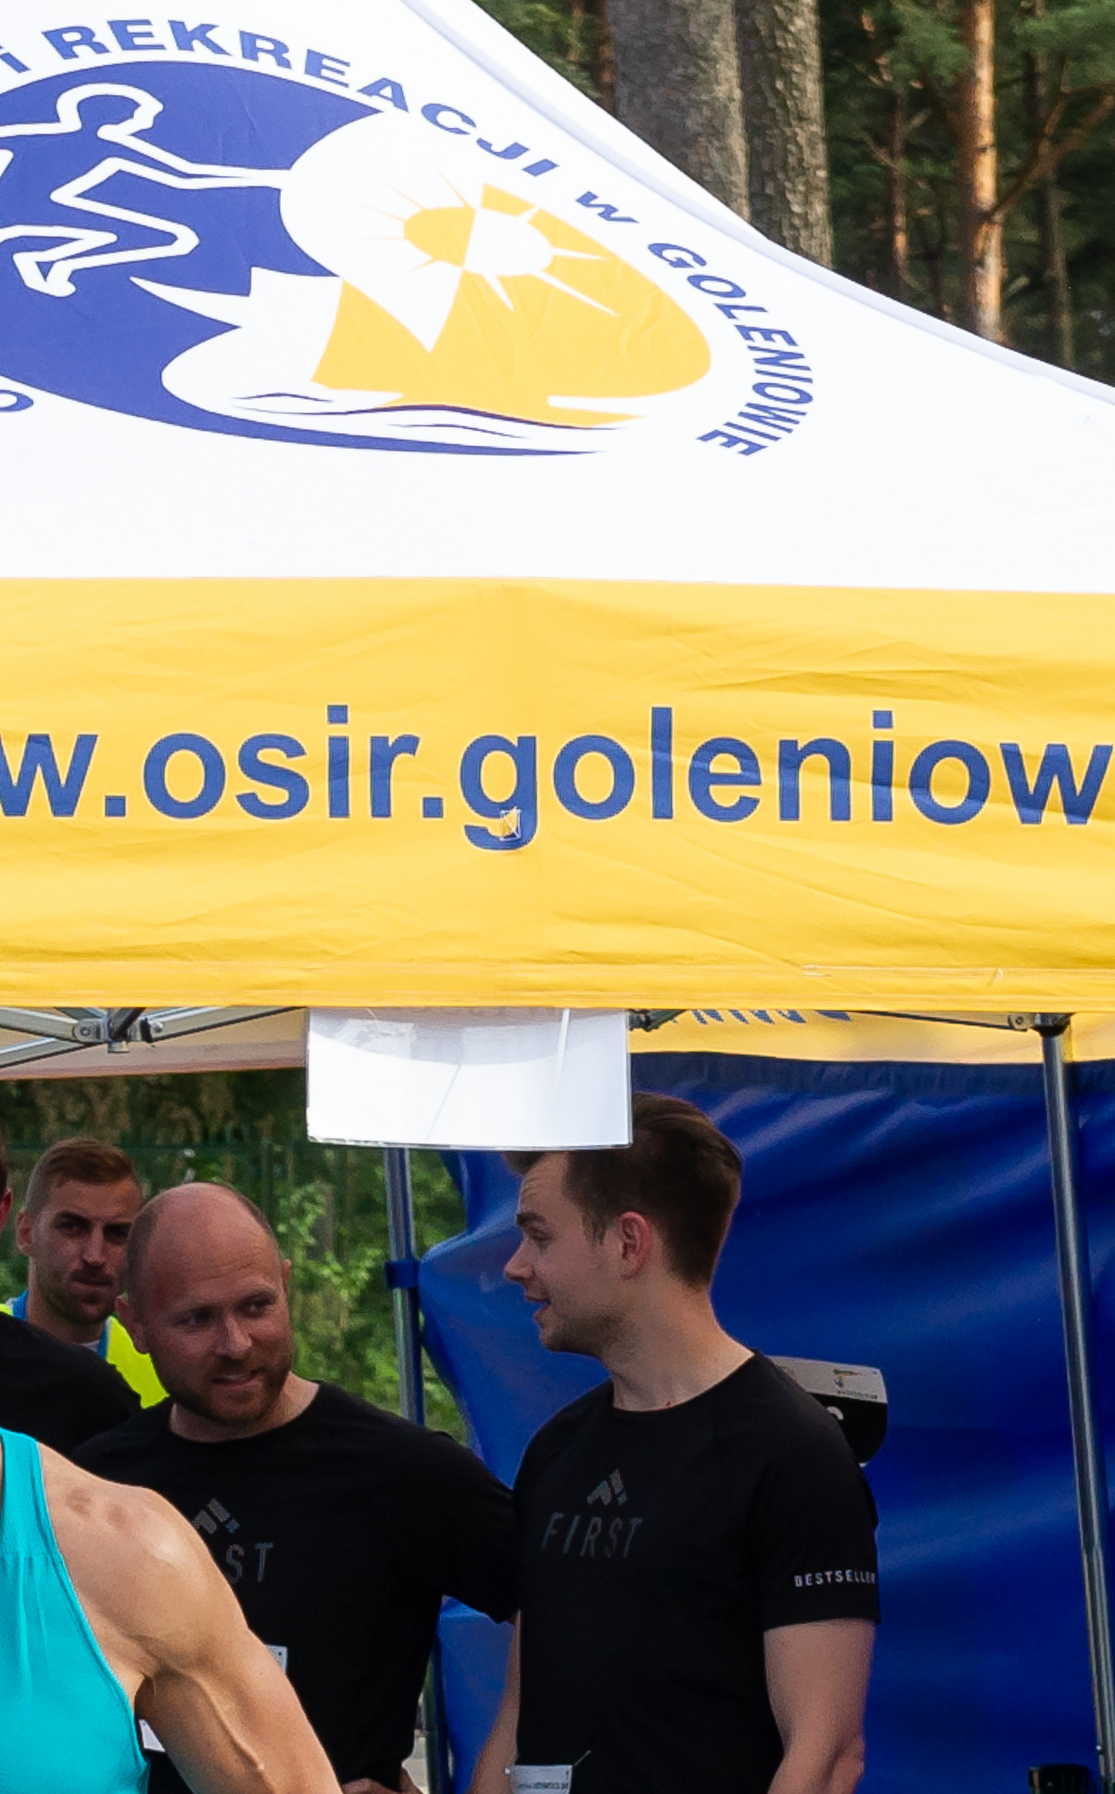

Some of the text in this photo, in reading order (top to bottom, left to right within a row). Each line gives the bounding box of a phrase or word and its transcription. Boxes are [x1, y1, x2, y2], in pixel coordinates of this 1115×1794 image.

[43, 18, 561, 175] REKREACJI
[648, 242, 814, 457] GOLENIOWIE
[541, 1511, 644, 1558] FIRST
